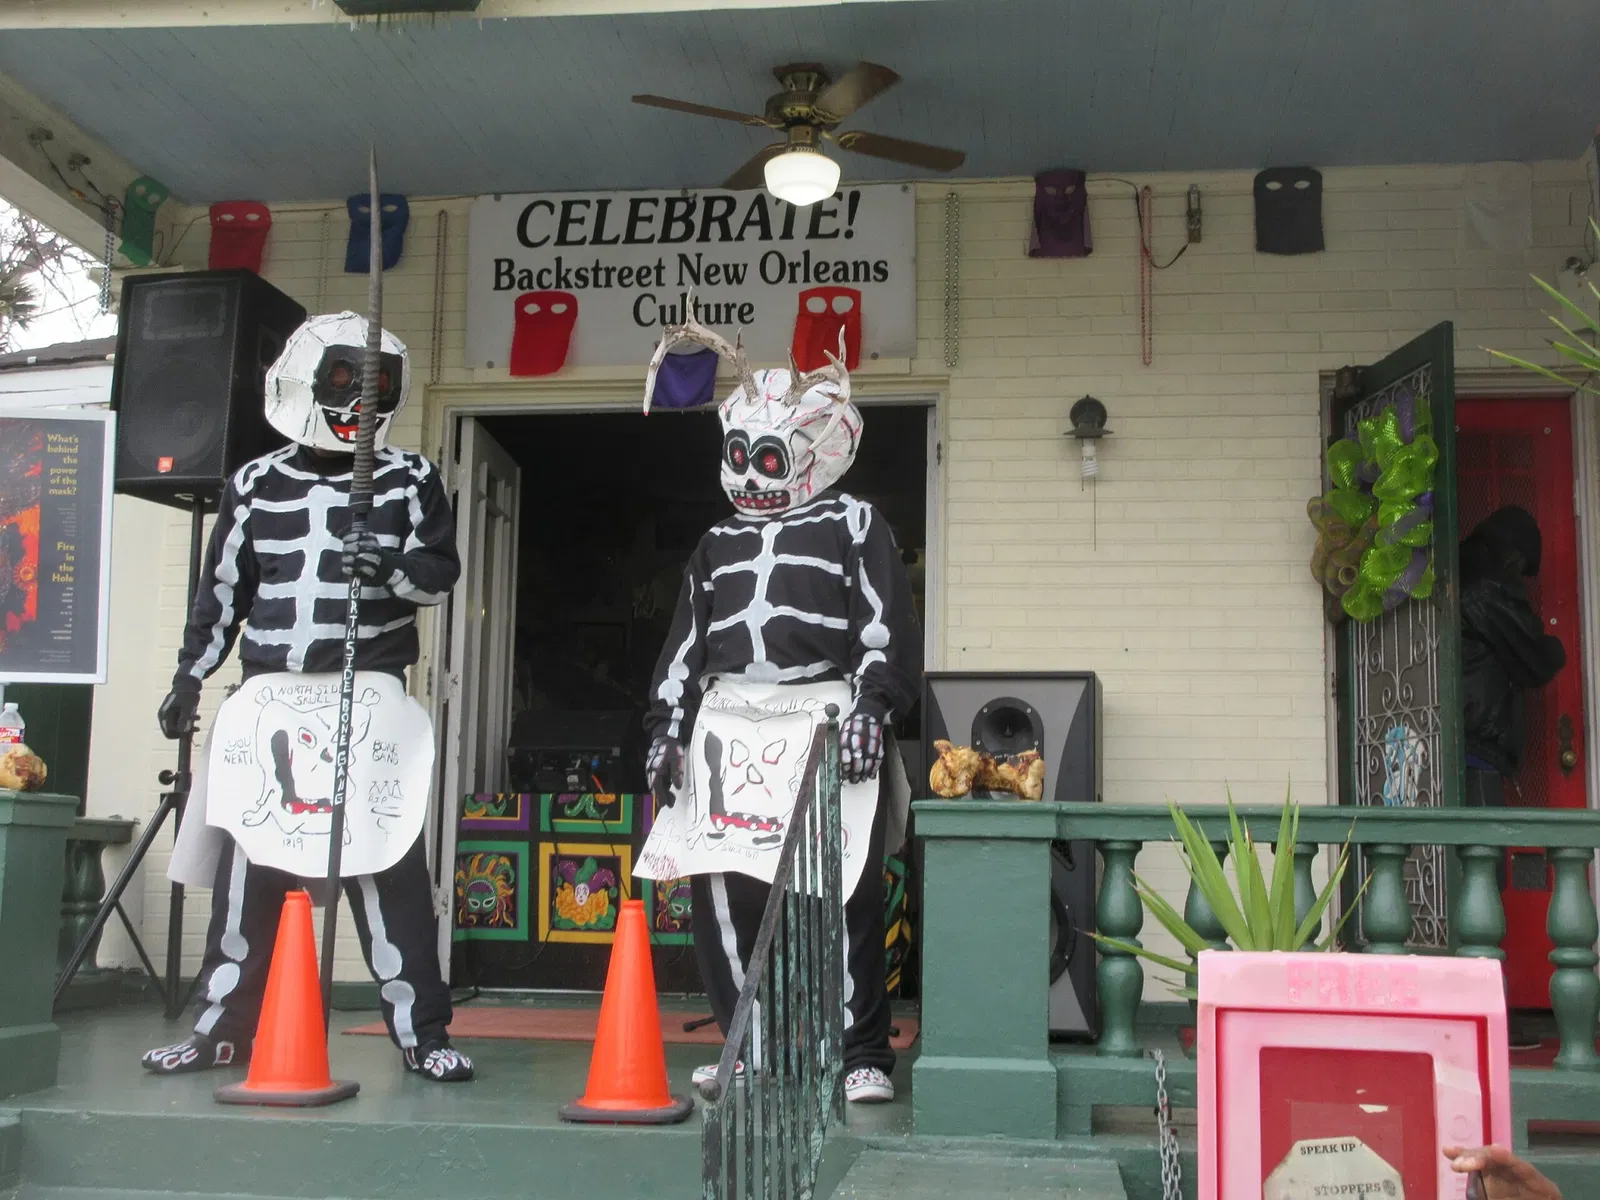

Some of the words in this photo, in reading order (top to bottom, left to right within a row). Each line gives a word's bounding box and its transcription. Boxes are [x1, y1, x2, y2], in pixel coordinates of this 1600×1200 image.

[516, 189, 861, 248] CELEBRATE!
[493, 256, 666, 291] Backstreet
[677, 252, 748, 286] New
[759, 249, 889, 285] Orleans
[633, 292, 755, 327] Culture
[47, 433, 79, 443] What's
[47, 444, 79, 453] behind
[63, 456, 78, 464] the
[50, 468, 77, 476] power
[50, 476, 61, 485] of
[49, 487, 77, 496] mask?
[56, 541, 75, 551] Fire
[65, 553, 75, 561] in
[59, 563, 74, 572] the
[51, 573, 74, 583] Hole
[339, 698, 350, 747] BONE
[334, 751, 347, 806] GANG
[1286, 960, 1421, 1007] FREE
[1300, 1144, 1338, 1156] SPEAK
[1340, 1143, 1357, 1153] UP
[1313, 1182, 1382, 1196] STOPPERS
